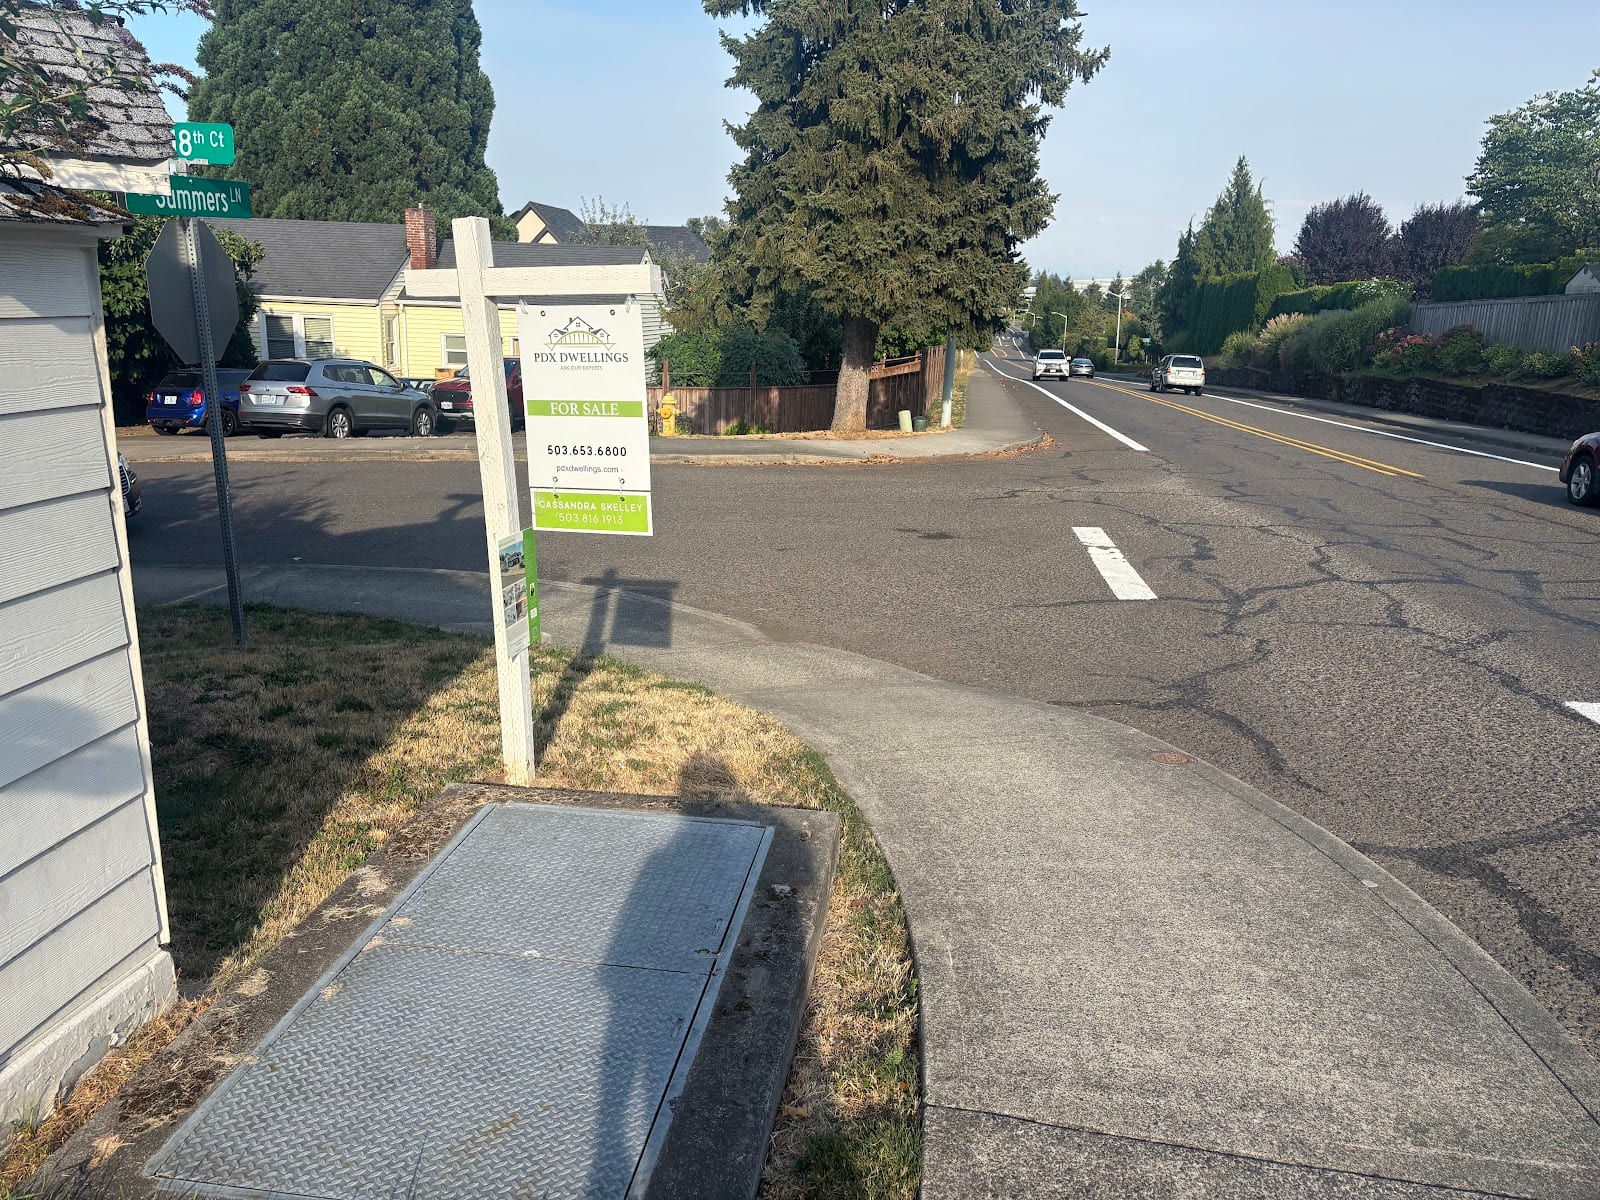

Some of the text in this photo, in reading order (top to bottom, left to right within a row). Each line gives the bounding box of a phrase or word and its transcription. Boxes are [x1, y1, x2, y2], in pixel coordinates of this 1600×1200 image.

[209, 130, 225, 148] Ct
[229, 187, 242, 203] LN
[534, 352, 629, 363] PDX DWELLINGS
[550, 402, 619, 416] FOR SALE
[547, 444, 627, 457] 503.653.6800
[556, 464, 619, 474] pdxdwellings.com
[539, 499, 643, 513] CASSANDRA SKELLEY
[558, 512, 623, 525] 503.816.1913
